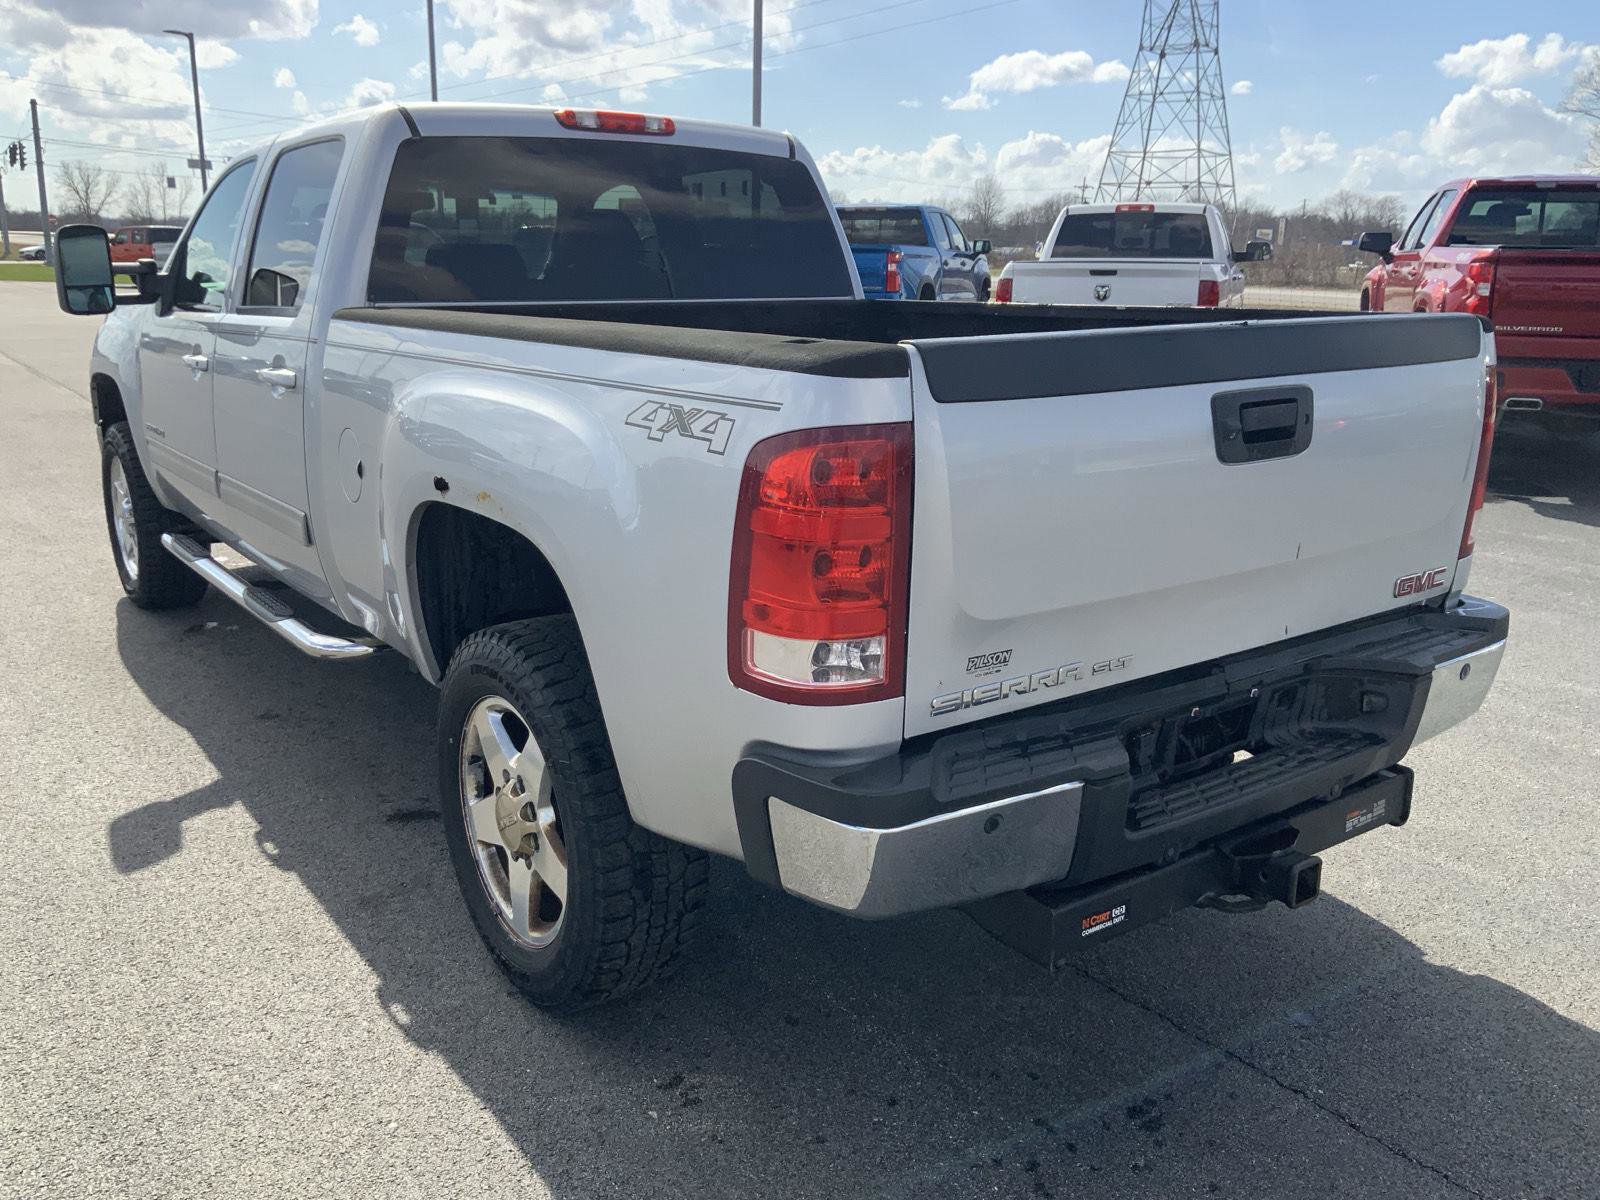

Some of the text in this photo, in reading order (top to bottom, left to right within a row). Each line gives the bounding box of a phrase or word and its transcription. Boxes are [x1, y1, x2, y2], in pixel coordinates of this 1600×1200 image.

[1393, 566, 1447, 598] GMC
[965, 649, 1013, 671] PILSON
[930, 654, 1135, 717] SIERRA SLT
[1081, 915, 1126, 937] COMMERCIAL DUTY
